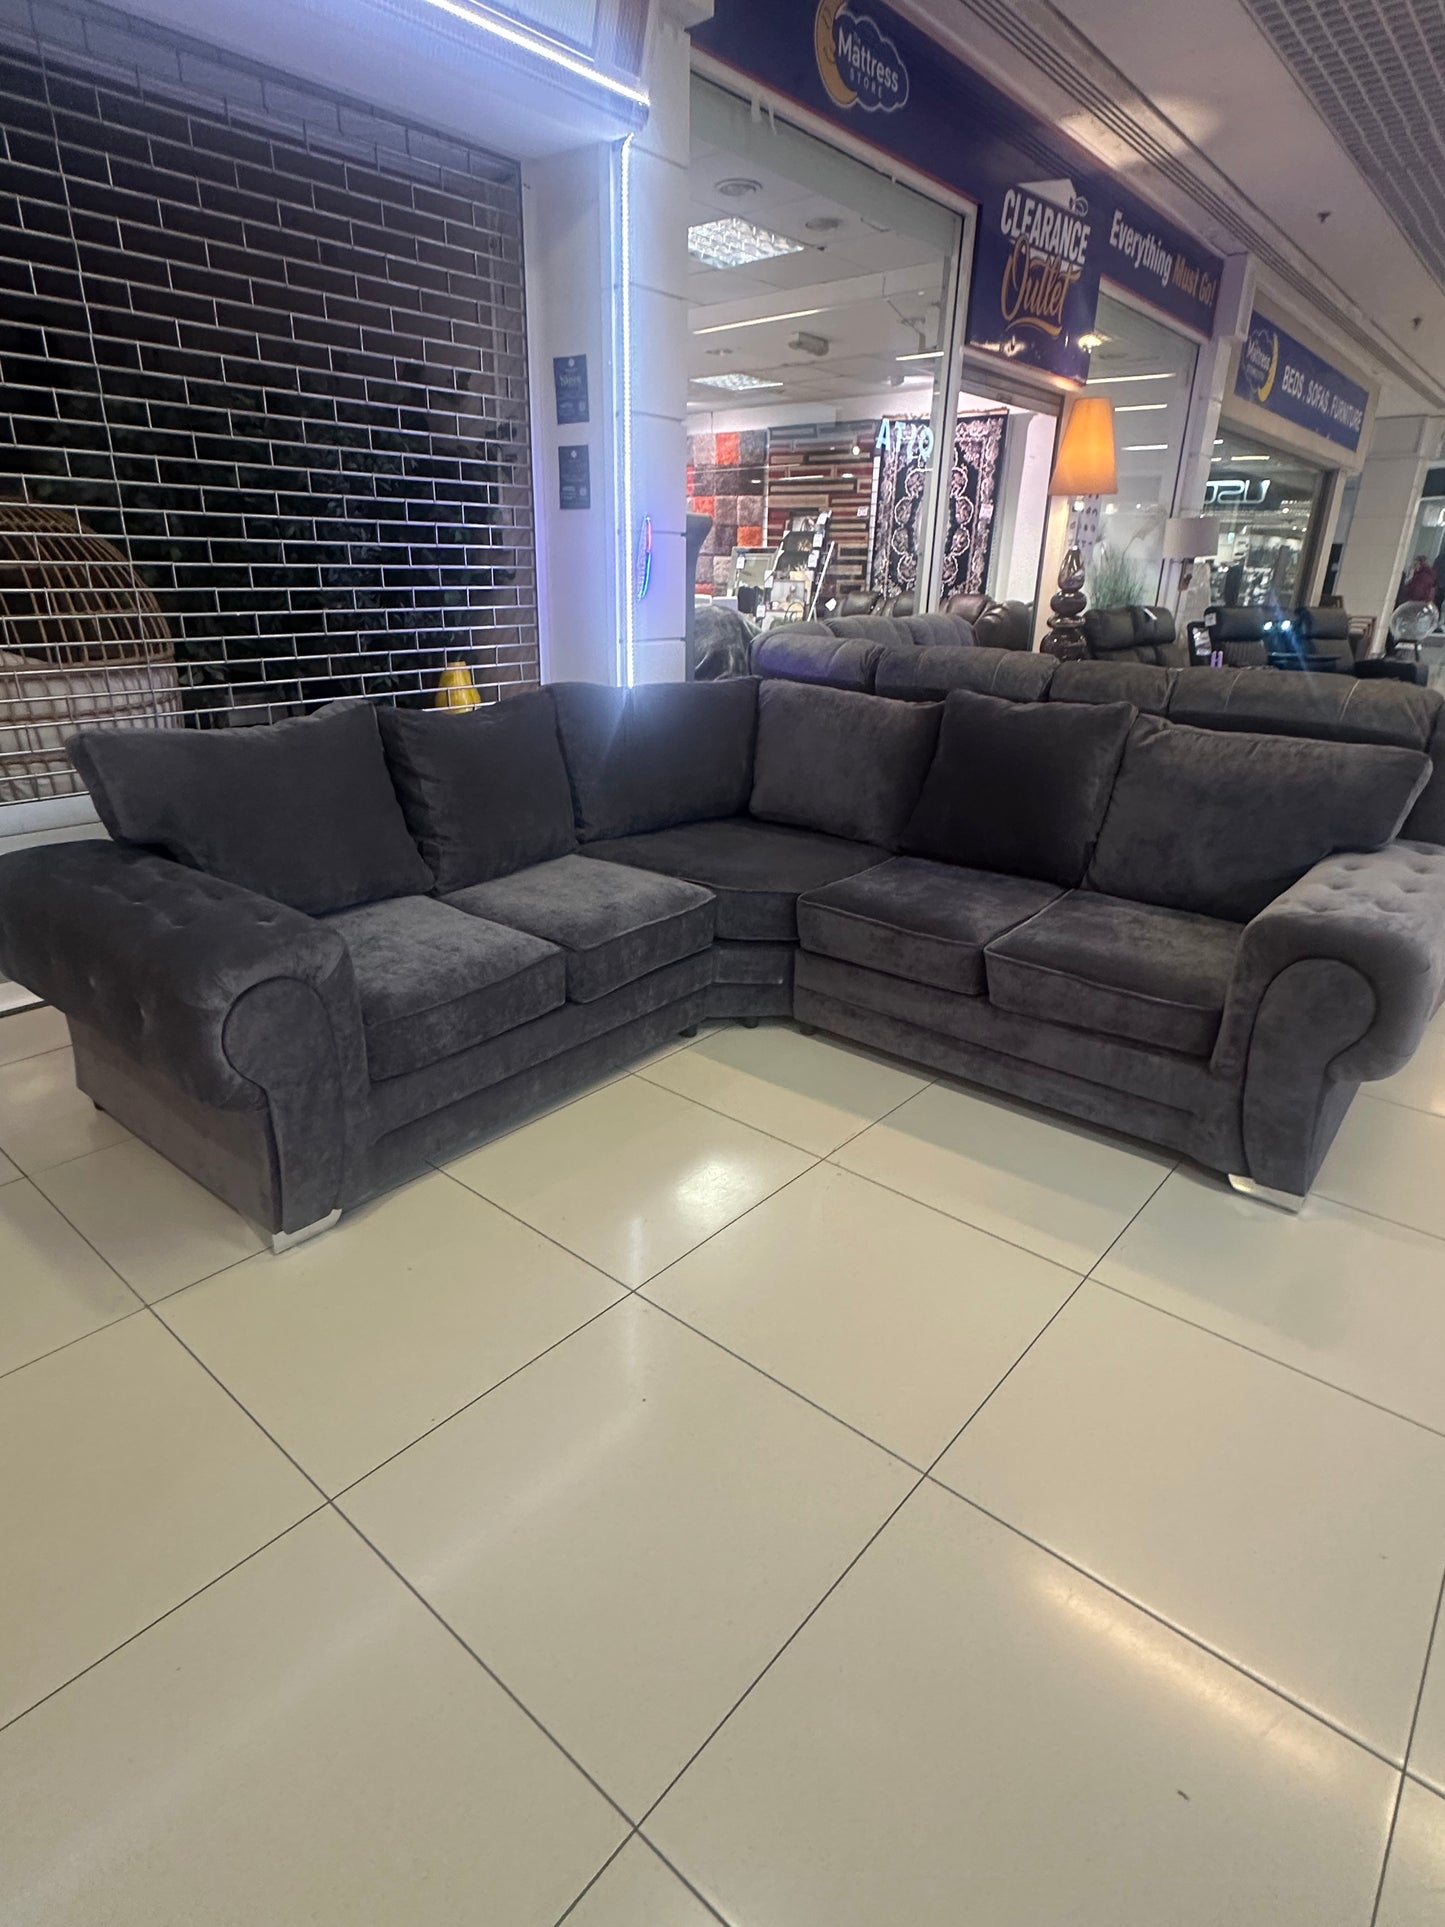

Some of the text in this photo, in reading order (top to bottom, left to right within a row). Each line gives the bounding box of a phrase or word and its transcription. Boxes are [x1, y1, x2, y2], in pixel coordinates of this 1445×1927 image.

[838, 26, 899, 93] Mattress
[1001, 188, 1092, 265] CLEARANCE
[1109, 208, 1173, 288] Everything
[1171, 253, 1200, 298] Must
[1001, 234, 1082, 325] Outlet
[1281, 364, 1305, 399] BEDS
[1306, 380, 1331, 414] SOFAS
